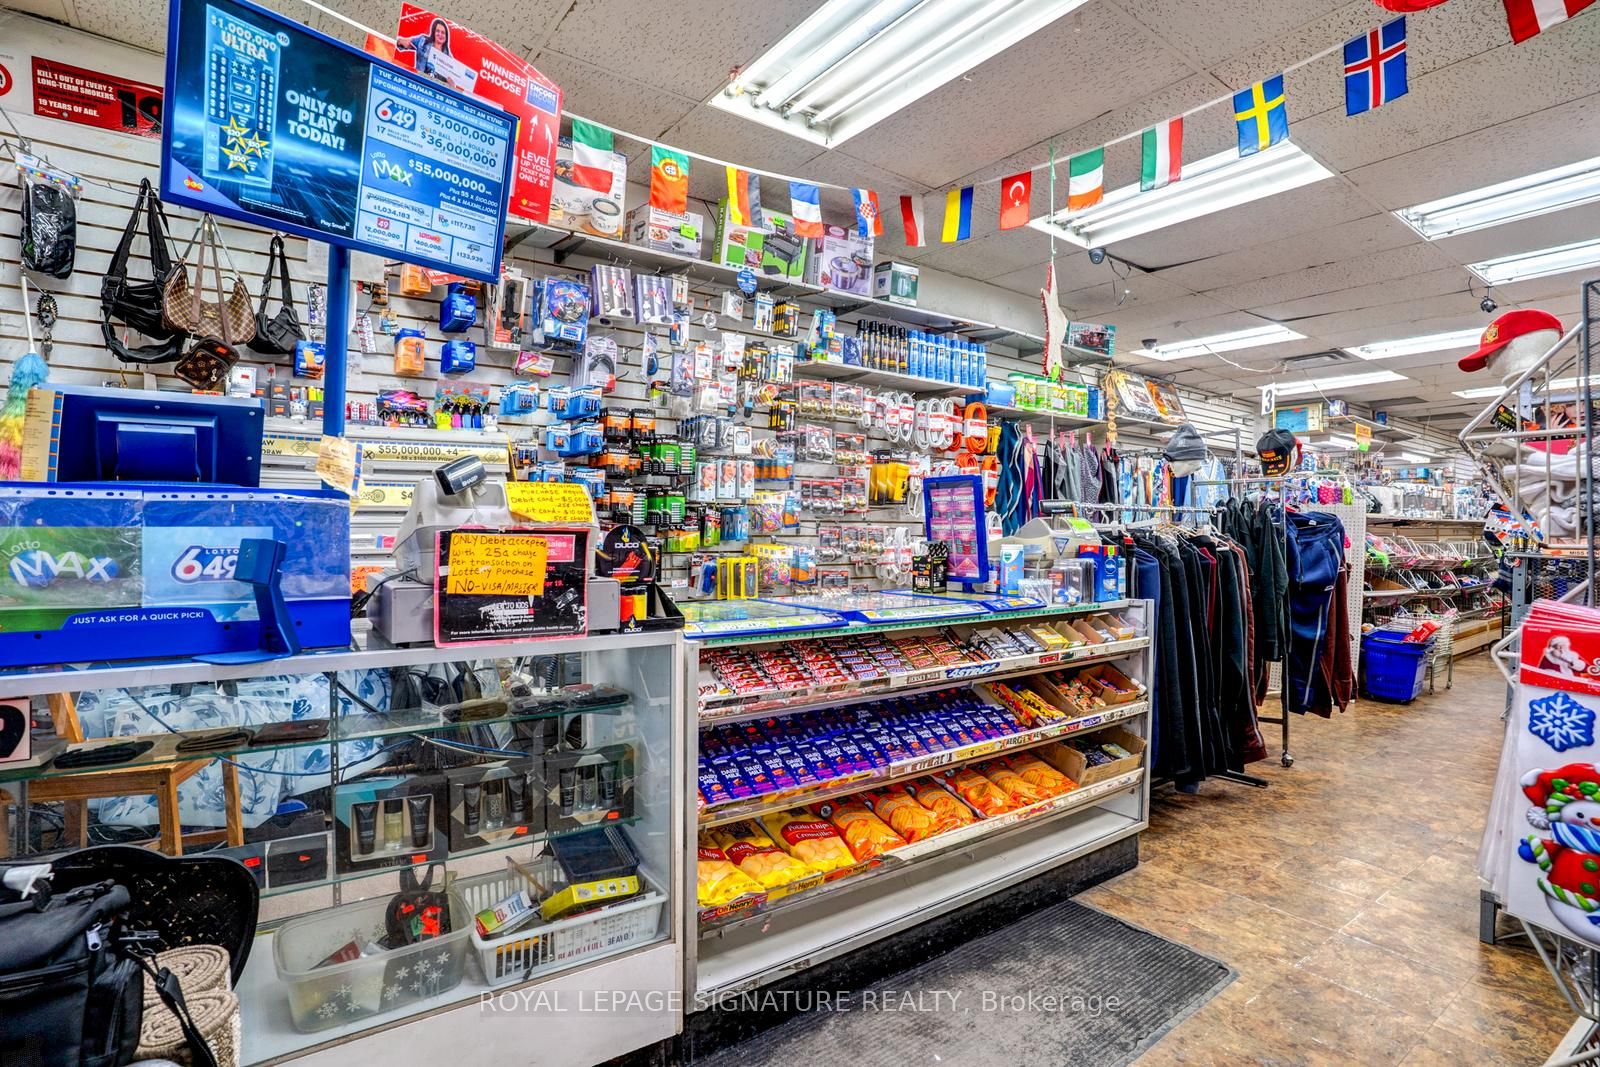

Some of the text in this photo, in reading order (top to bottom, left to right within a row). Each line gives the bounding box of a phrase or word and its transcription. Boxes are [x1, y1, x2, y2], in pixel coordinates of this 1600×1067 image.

[220, 31, 268, 63] ULTRA
[37, 69, 54, 80] KILL
[59, 75, 74, 84] OUT
[85, 81, 107, 91] EVERY
[482, 57, 528, 88] WINNERS
[38, 77, 79, 93] LONG-TERM
[80, 87, 116, 101] SMOKERS.
[480, 70, 522, 96] CHOOSE
[530, 82, 557, 102] ENCORE
[378, 70, 392, 81] TUE
[393, 75, 406, 86] APR
[446, 96, 458, 108] AVR.
[463, 104, 476, 114] 11:21
[476, 110, 486, 118] AM
[38, 98, 100, 117] 19 YEARS OF AGE.
[286, 90, 352, 124] ONLY $10
[373, 78, 508, 136] UPCOMING JACKPOTS PROCHAINS GROS LOTS
[376, 98, 416, 130] 649
[394, 103, 414, 114] LOTTO
[299, 109, 338, 134] PLAY
[376, 124, 386, 134] 17
[428, 111, 495, 146] $5,000,000
[288, 120, 346, 151] TODAY!
[420, 130, 496, 168] $36,000,000
[522, 149, 551, 168] LEVEL
[372, 159, 414, 187] MAX
[408, 158, 486, 194] $55,000,000
[520, 160, 550, 175] UP YOUR
[520, 166, 550, 180] TICKET FOR
[518, 173, 548, 188] ONLY $1.
[440, 192, 450, 200] Plus
[462, 200, 496, 215] MAXMILLIONS
[449, 187, 460, 196] Plus
[475, 194, 498, 208] $100,000
[320, 219, 346, 231] Play Smart
[364, 226, 400, 240] $2,000,000
[457, 252, 484, 263] $133,939
[1264, 390, 1273, 412] 3
[378, 445, 458, 456] $55,000,000 +4
[462, 475, 478, 487] SHARP
[5, 540, 40, 558] Lotto
[452, 534, 547, 549] ONLY Debit accepted
[205, 548, 240, 556] LOTTO
[512, 548, 537, 558] charge
[9, 550, 114, 589] MAX
[173, 547, 240, 583] 649
[470, 558, 520, 567] transaction
[73, 611, 204, 626] JUST ASK FOR A QUICK PICK!
[788, 822, 829, 832] Potato Chips
[699, 848, 720, 859] Chips
[798, 877, 823, 890] Henry!
[717, 898, 754, 915] Oh Henry!
